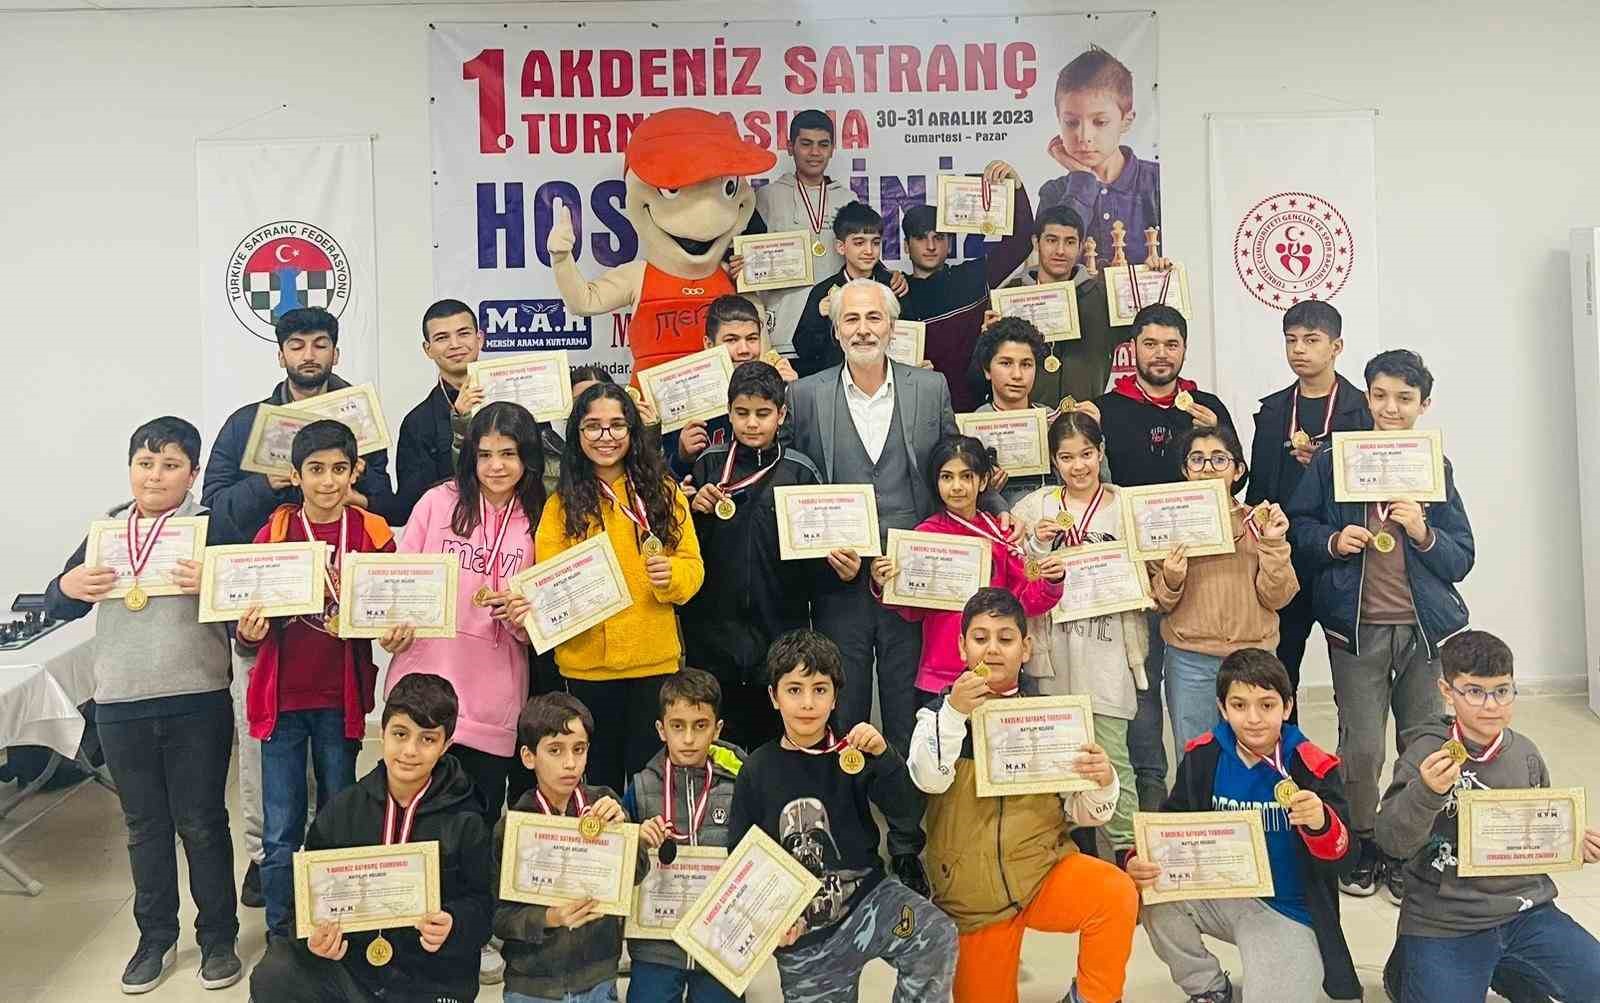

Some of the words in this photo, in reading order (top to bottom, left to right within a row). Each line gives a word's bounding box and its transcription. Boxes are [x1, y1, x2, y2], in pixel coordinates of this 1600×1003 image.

[521, 37, 762, 98] AKDENİZ
[784, 41, 1038, 100] SATRANÇ
[876, 108, 924, 128] 30-31
[928, 110, 987, 127] ARALIK
[992, 109, 1034, 125] 2023
[975, 131, 1008, 142] Pazar
[244, 224, 297, 252] SATRANÇ
[301, 226, 348, 300] FEDERASYONU
